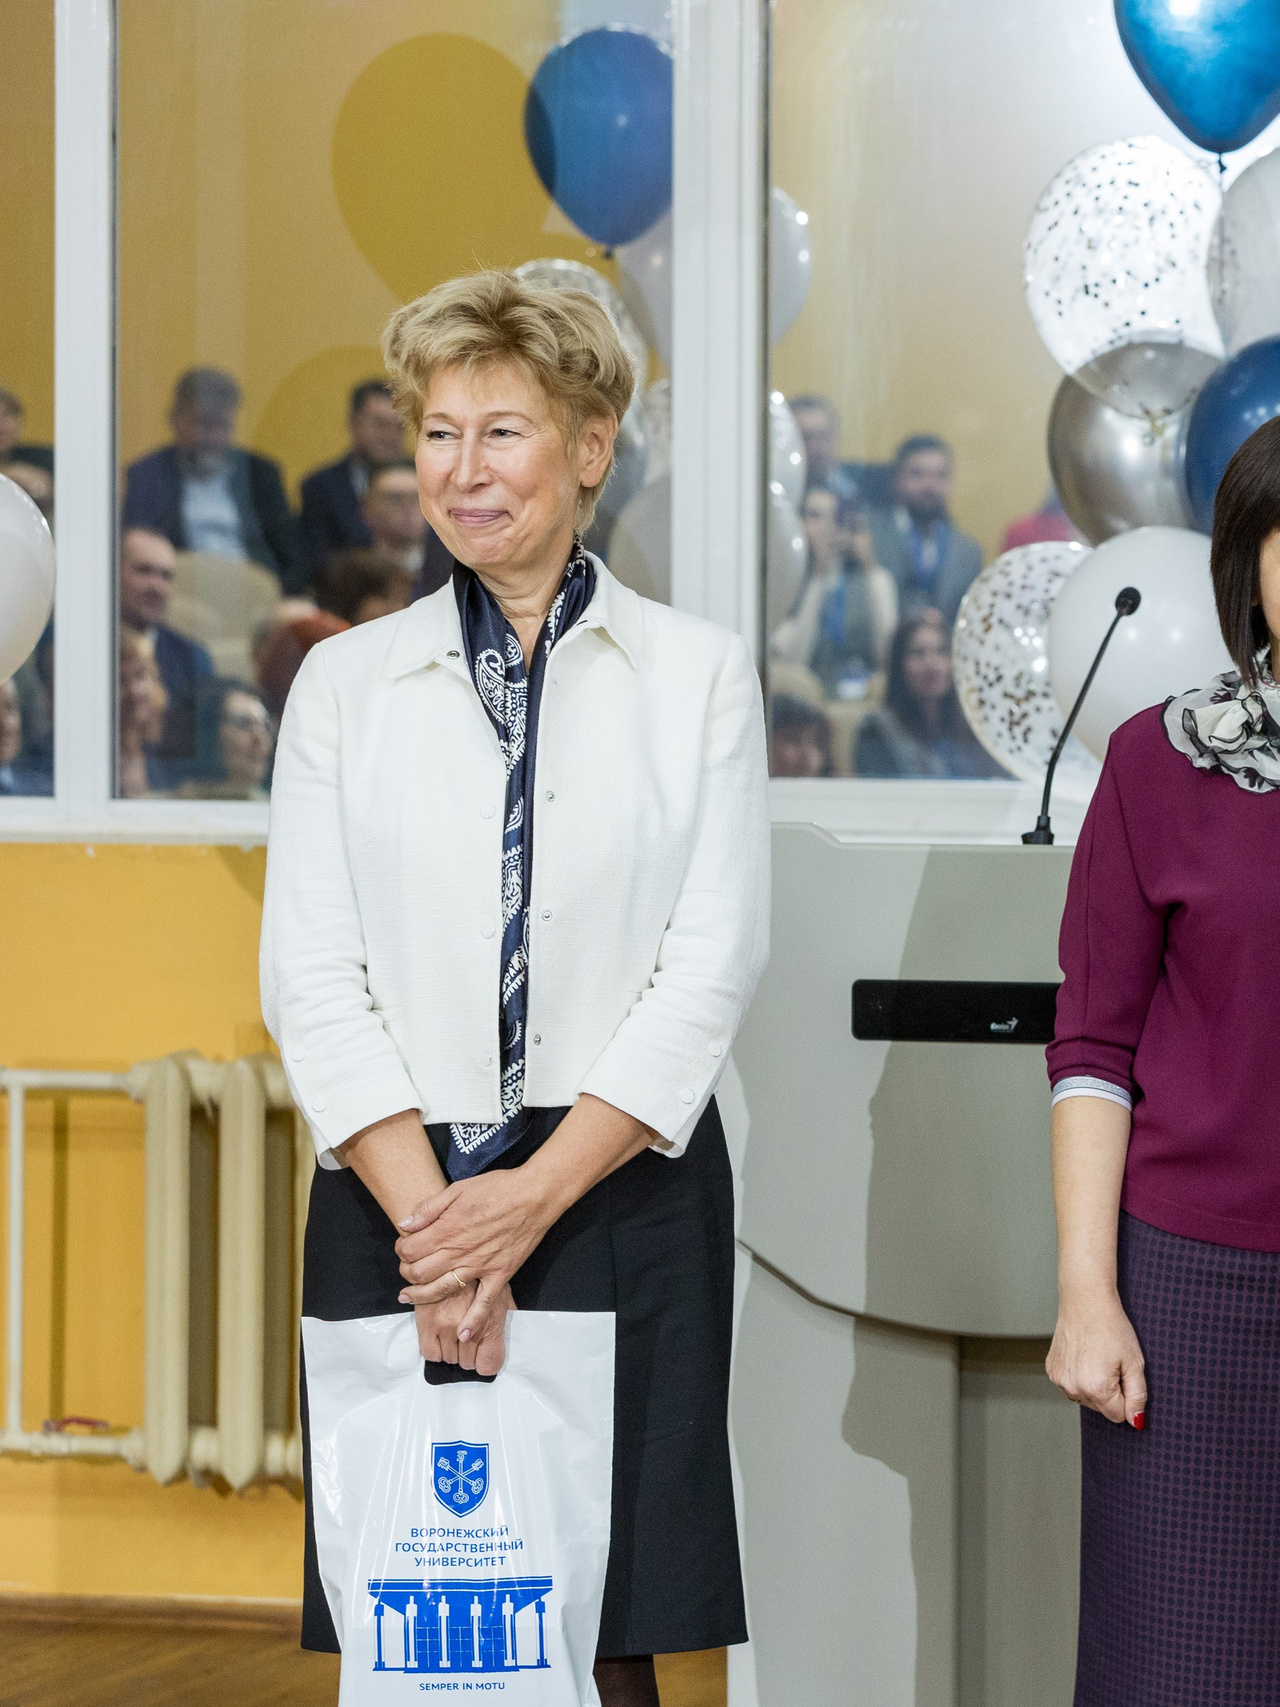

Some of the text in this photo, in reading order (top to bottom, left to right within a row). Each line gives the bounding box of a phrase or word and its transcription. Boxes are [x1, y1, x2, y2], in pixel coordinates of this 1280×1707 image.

[410, 1525, 509, 1539] ВОРОНЕЖСКИЙ
[395, 1538, 524, 1553] ГОСУДАРСТВЕННЫЙ
[414, 1556, 507, 1568] УНИВЕРСИТЕТ
[419, 1682, 506, 1691] SEMPER IN MOTU
